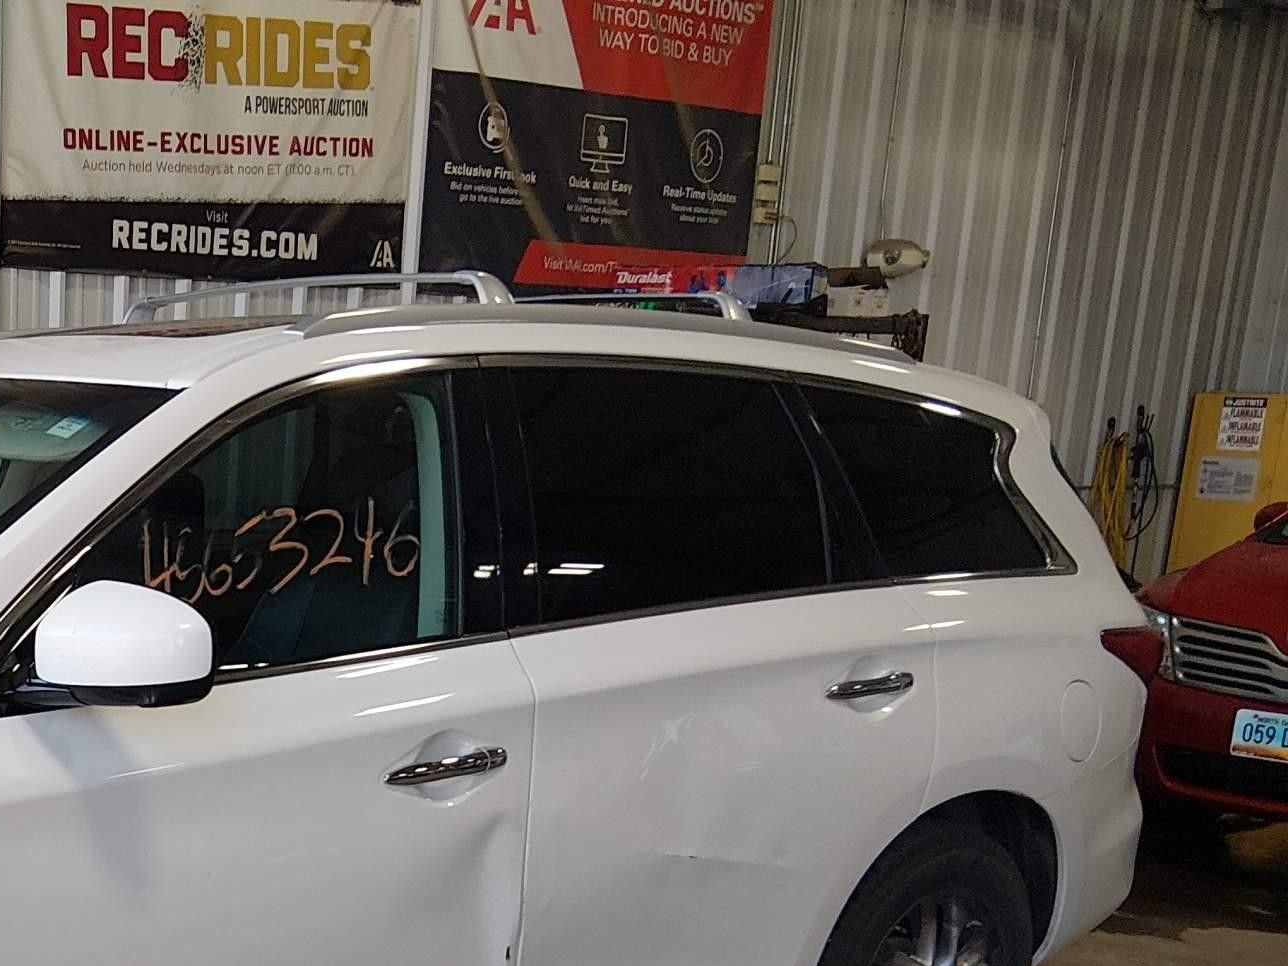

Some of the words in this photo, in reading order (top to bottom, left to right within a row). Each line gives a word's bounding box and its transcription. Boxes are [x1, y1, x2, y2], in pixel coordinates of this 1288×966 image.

[592, 5, 694, 37] INTRODUCING
[696, 23, 707, 38] A
[710, 25, 744, 45] NEW
[599, 28, 635, 50] WAY
[638, 34, 659, 53] TO
[663, 40, 684, 60] BID
[688, 44, 698, 61] &
[703, 46, 734, 66] BUY
[244, 95, 252, 114] A
[255, 96, 326, 117] POWERSPORT
[326, 99, 369, 118] AUCTION
[63, 127, 280, 156] ONLINE-EXCLUSIVE
[289, 135, 374, 158] AUCTION
[82, 159, 126, 173] Auction
[128, 160, 153, 174] held
[155, 161, 221, 176] Wednesdays
[224, 164, 234, 175] at
[237, 166, 264, 176] noon
[267, 164, 282, 176] ET
[444, 161, 492, 179] Exclusive
[568, 175, 590, 190] Quick
[592, 181, 609, 192] and
[612, 180, 633, 196] Easy
[663, 185, 706, 200] Real-Time
[707, 190, 737, 204] Updates
[205, 210, 228, 223] Visit
[112, 219, 318, 262] RECRIDES.COM
[543, 256, 563, 270] Visit
[616, 271, 672, 284] Duralast
[1242, 722, 1276, 745] 059
